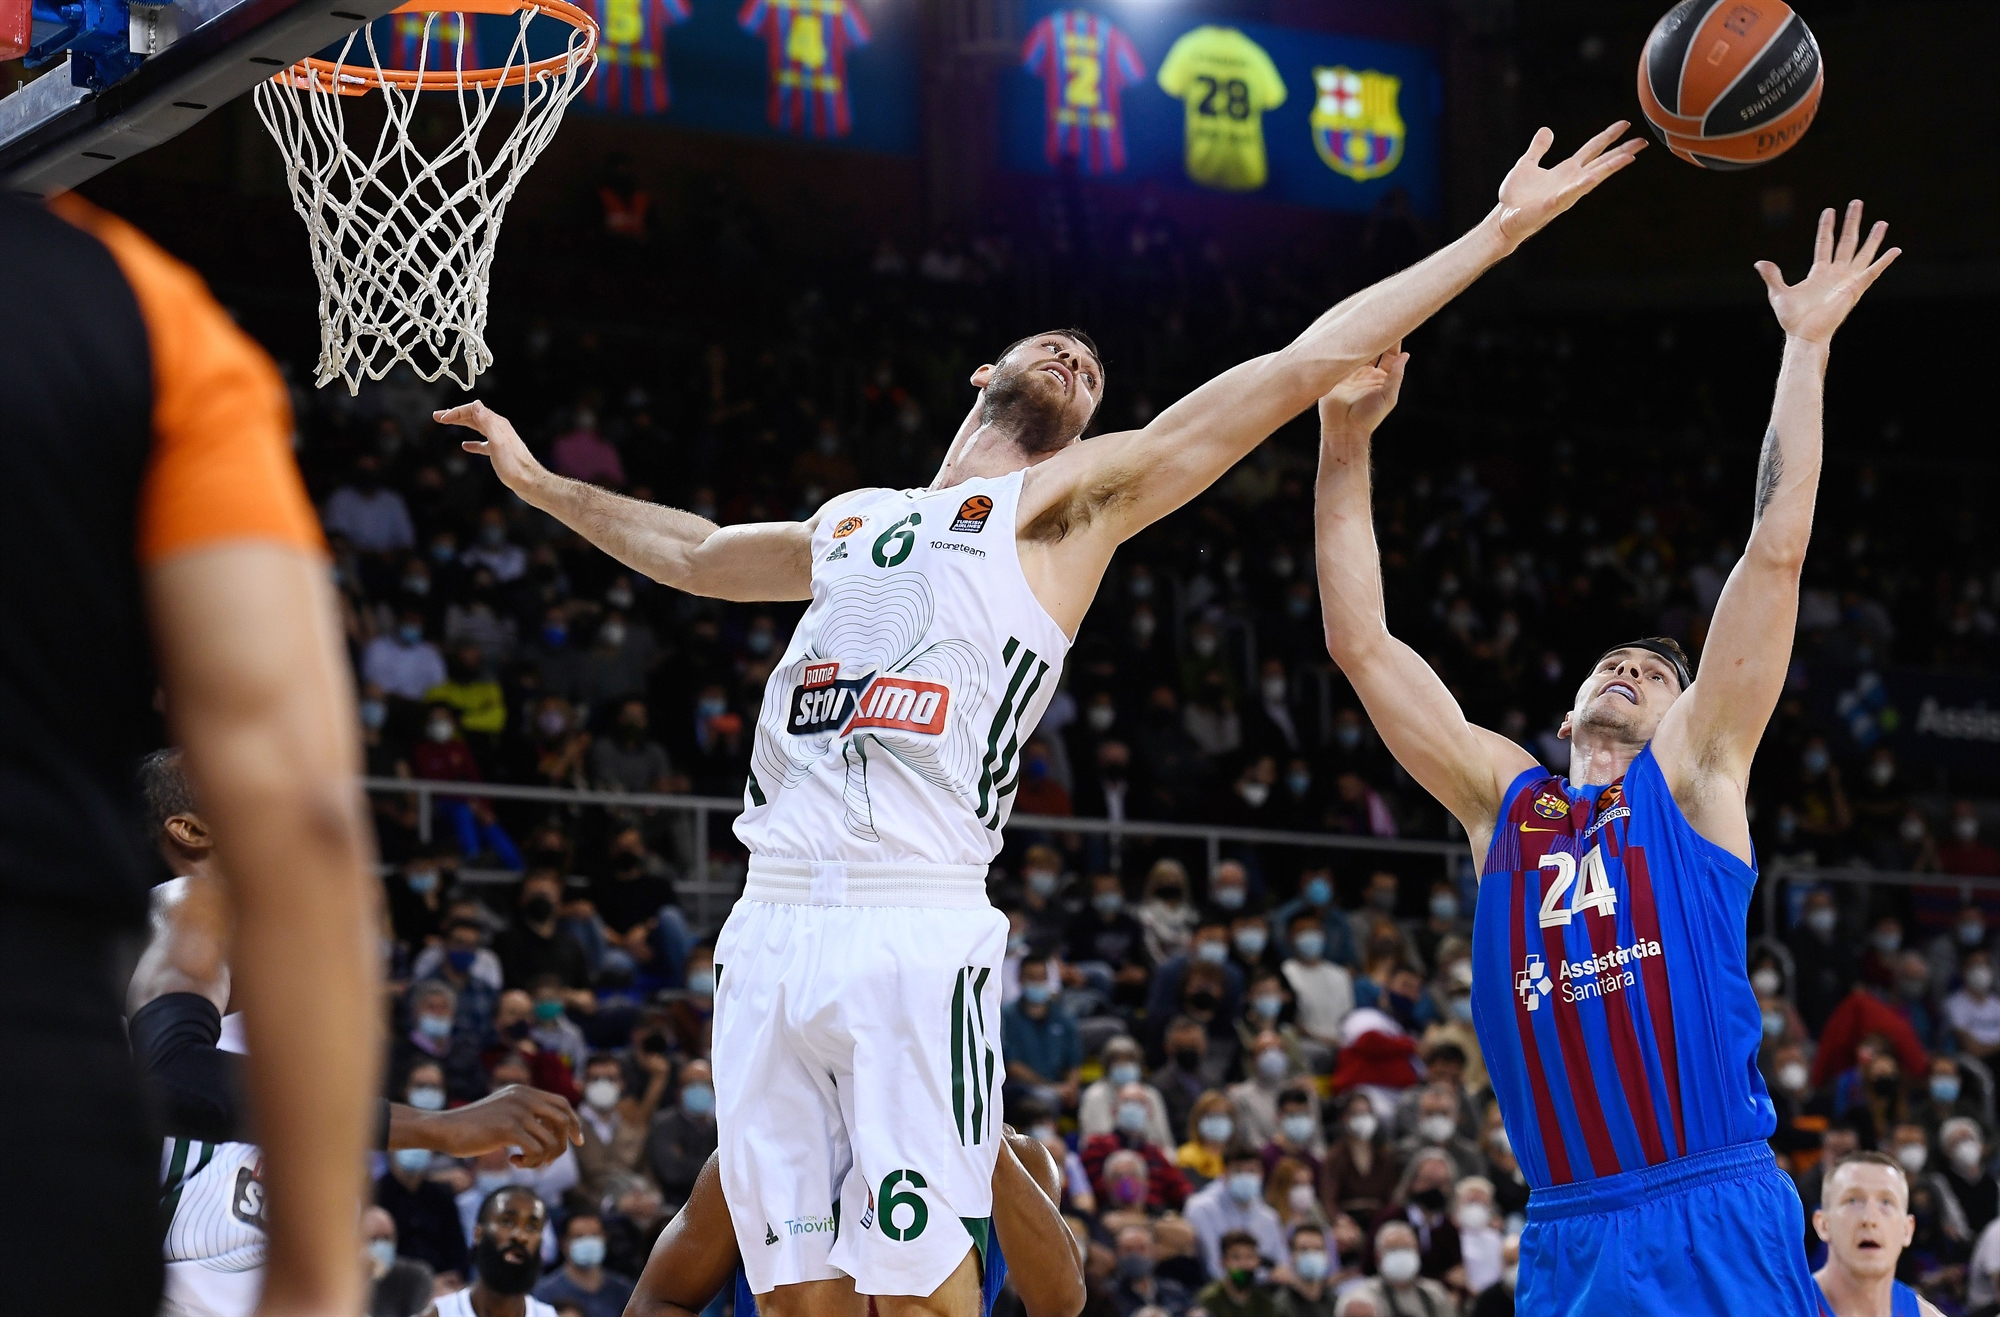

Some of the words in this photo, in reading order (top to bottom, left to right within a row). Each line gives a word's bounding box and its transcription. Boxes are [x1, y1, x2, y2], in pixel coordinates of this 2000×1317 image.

[1066, 56, 1101, 106] 2
[1195, 74, 1250, 120] 28
[872, 513, 922, 568] 6
[805, 666, 834, 686] pame
[1538, 844, 1617, 929] 24
[1559, 938, 1662, 981] Assistència
[1561, 969, 1635, 1003] Sanitàra
[877, 1168, 928, 1242] 6
